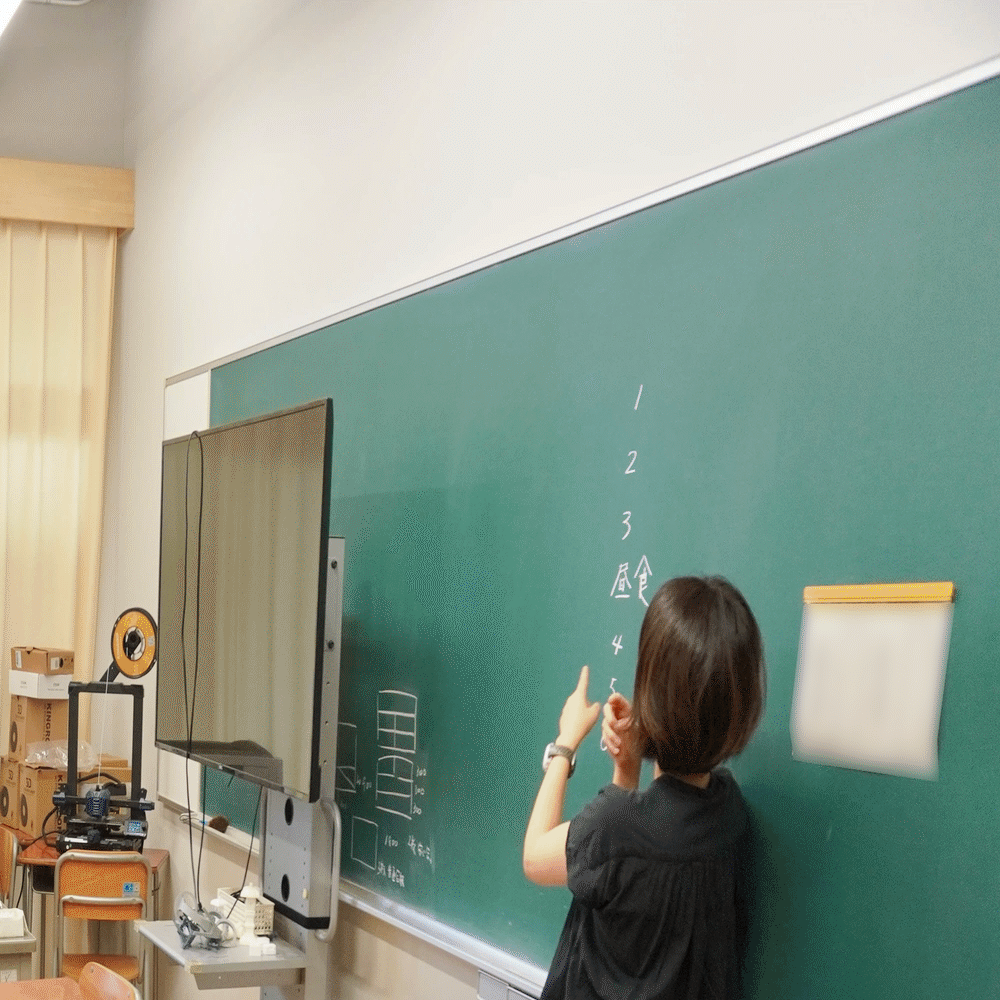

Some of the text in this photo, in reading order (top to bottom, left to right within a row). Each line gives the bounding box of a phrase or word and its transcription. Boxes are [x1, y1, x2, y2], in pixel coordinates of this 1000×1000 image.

[633, 384, 643, 411] 1
[624, 450, 637, 475] 2
[622, 510, 632, 540] 3
[610, 554, 653, 607] 昼食
[611, 634, 623, 655] 4
